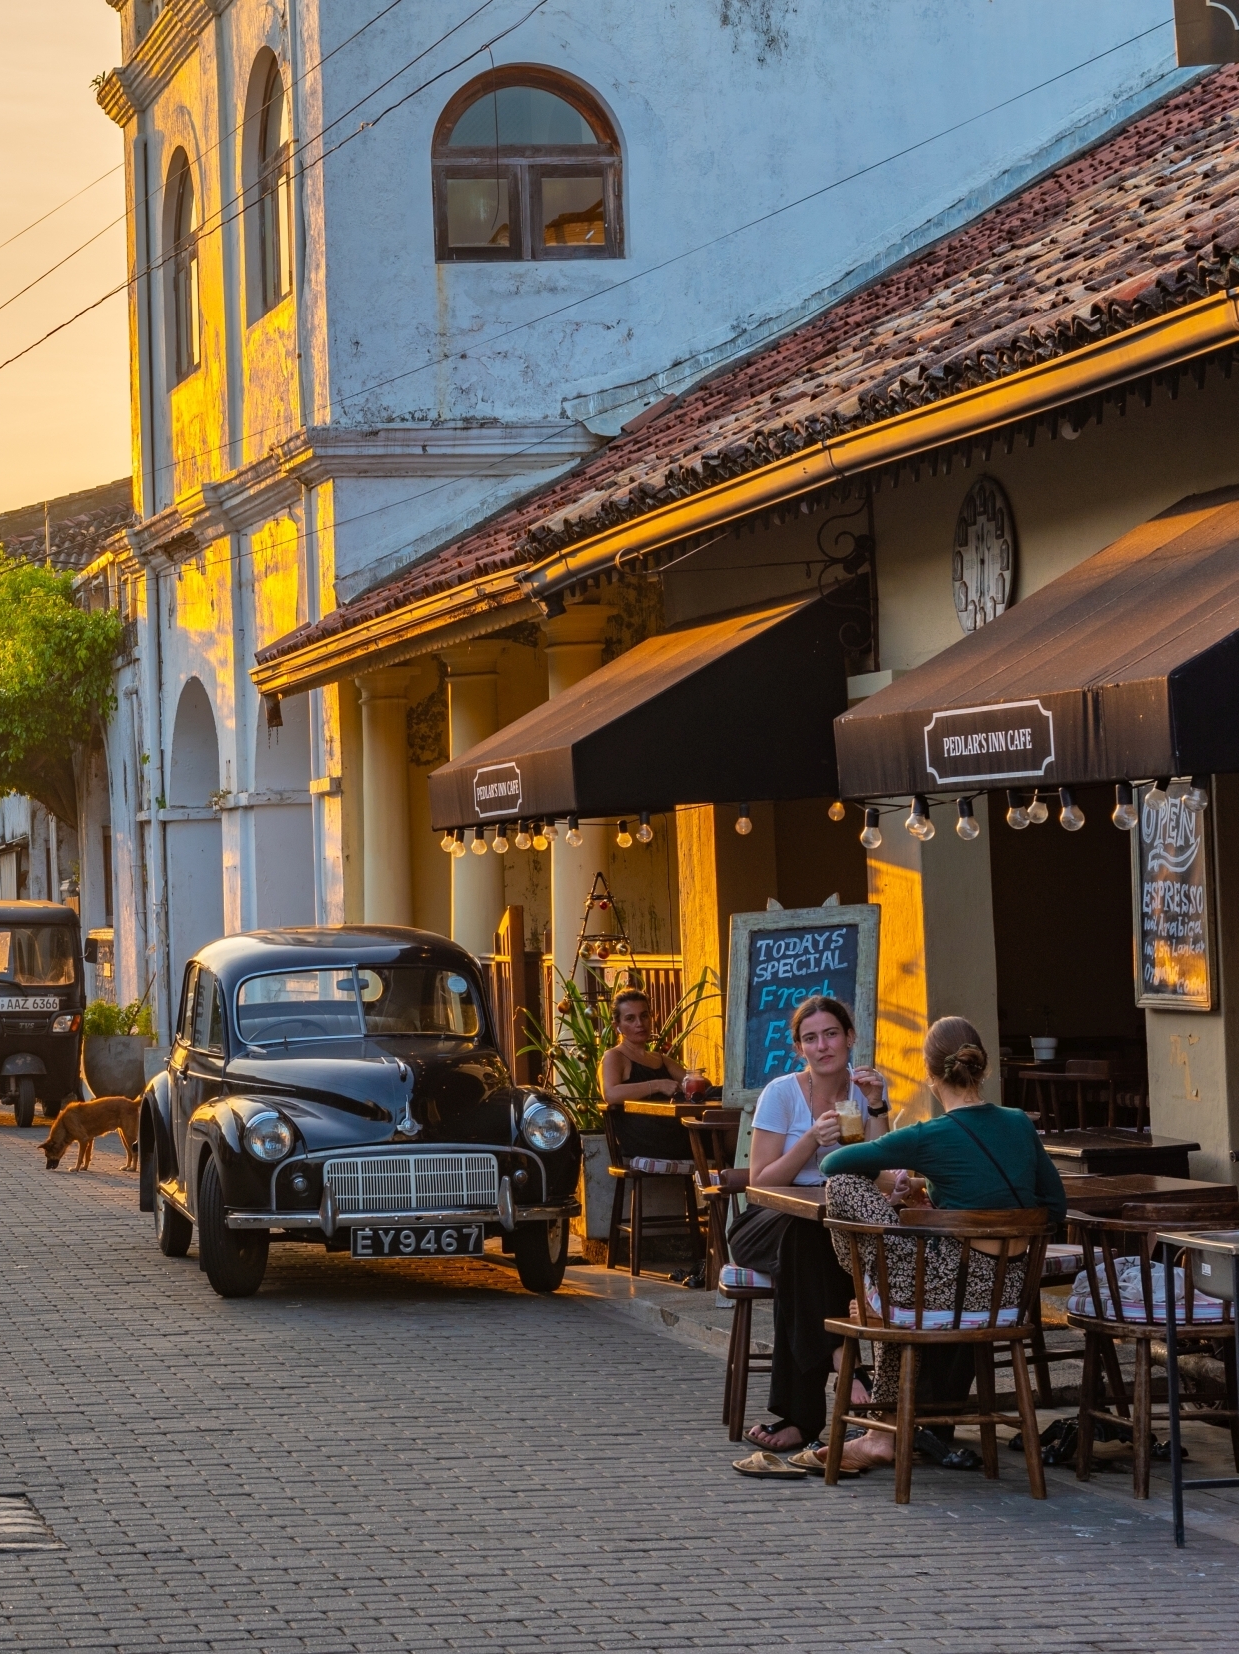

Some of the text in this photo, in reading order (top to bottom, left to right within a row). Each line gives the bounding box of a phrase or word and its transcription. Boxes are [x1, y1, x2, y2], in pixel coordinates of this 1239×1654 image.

[943, 728, 1032, 757] PEDLAR'S INN CAFE
[507, 780, 519, 795] CAFE
[1142, 796, 1196, 848] OPEN
[1142, 881, 1204, 914] ESPRESSO
[1158, 914, 1203, 937] Arabica
[756, 928, 847, 961] TODAYS
[753, 949, 849, 986] SPECIAL
[7, 998, 58, 1010] AAZ 6366
[357, 1227, 479, 1255] EY9467
